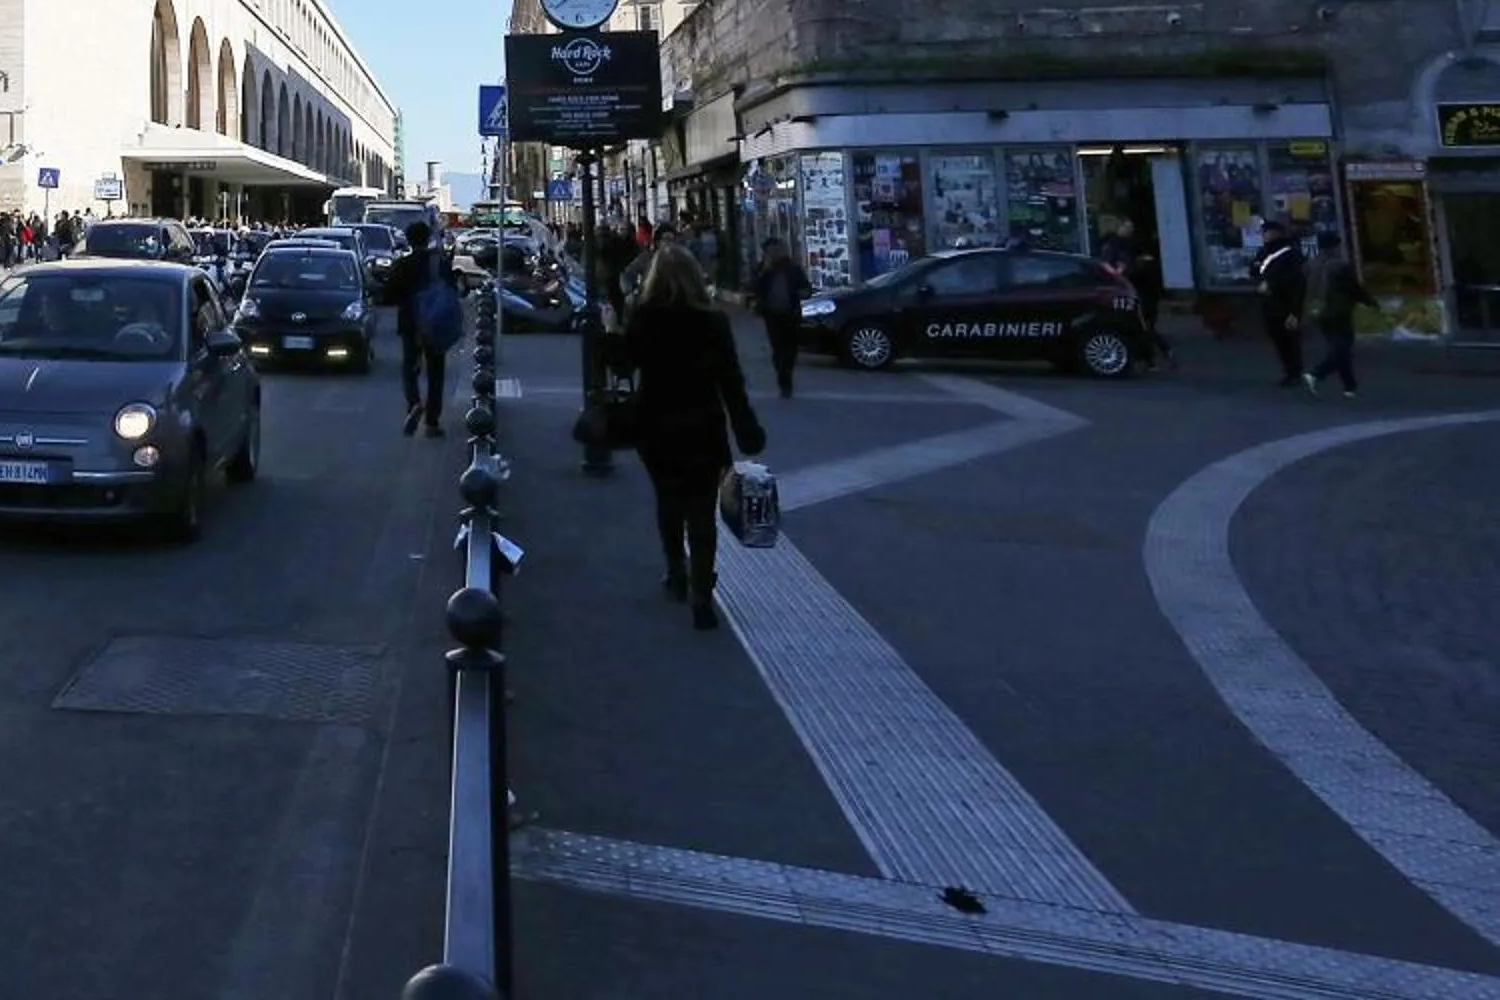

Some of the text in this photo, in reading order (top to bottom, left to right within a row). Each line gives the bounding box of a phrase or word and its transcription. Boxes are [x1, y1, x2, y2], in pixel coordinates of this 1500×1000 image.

[551, 45, 612, 61] Hard Rock
[1113, 297, 1135, 311] 112
[927, 322, 1063, 338] CARABINIERI
